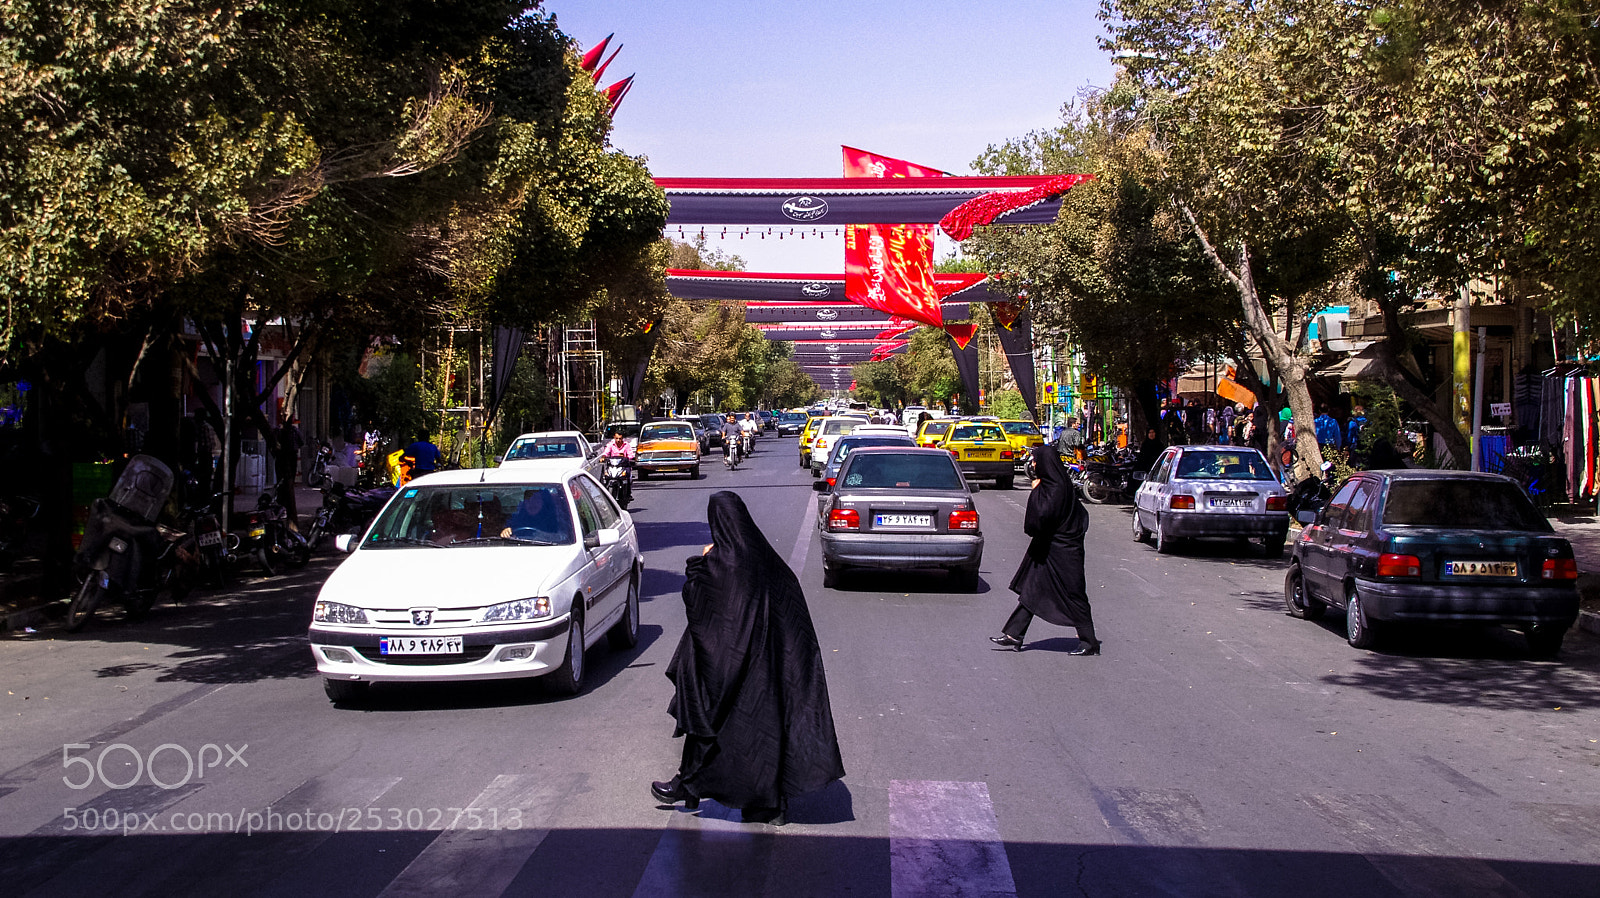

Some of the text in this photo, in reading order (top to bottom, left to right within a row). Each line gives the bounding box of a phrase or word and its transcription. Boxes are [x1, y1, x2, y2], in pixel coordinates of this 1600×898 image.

[1453, 563, 1467, 573] ۵۸
[390, 639, 405, 652] ۸۸
[409, 640, 416, 651] و
[420, 639, 443, 652] ۴۸۶
